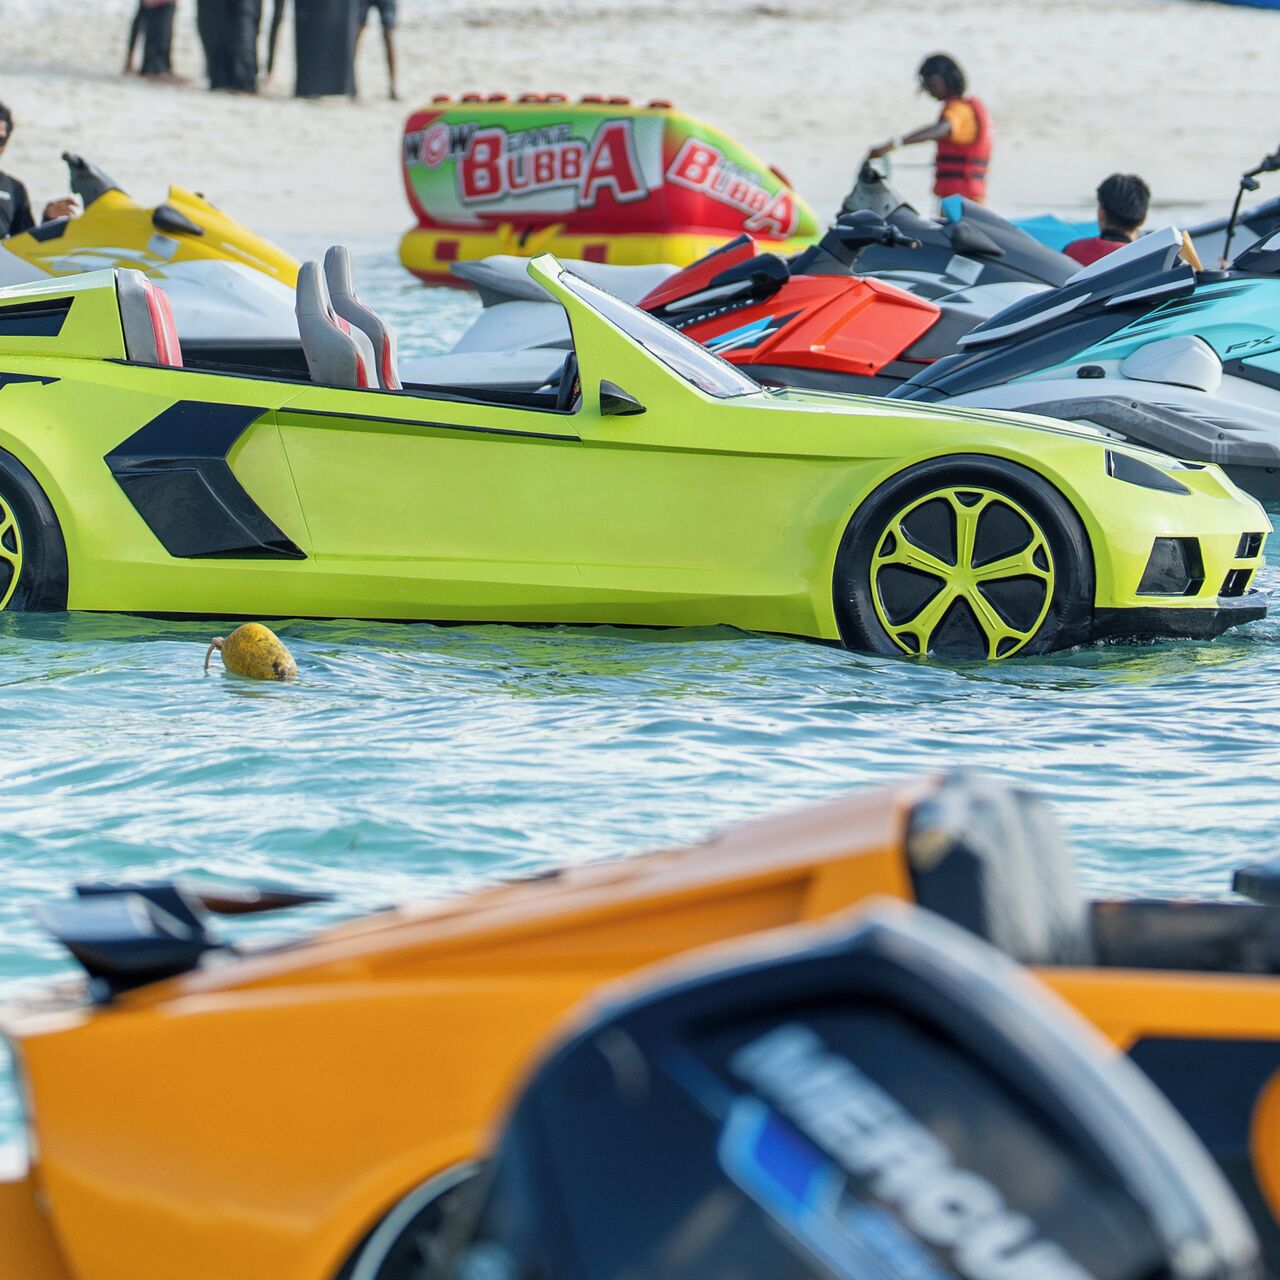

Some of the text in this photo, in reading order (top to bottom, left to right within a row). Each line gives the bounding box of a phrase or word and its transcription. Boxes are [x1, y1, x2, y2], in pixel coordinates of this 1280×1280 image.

[459, 120, 648, 207] BUBBA
[666, 137, 799, 240] BUBBA
[1225, 334, 1277, 354] FX
